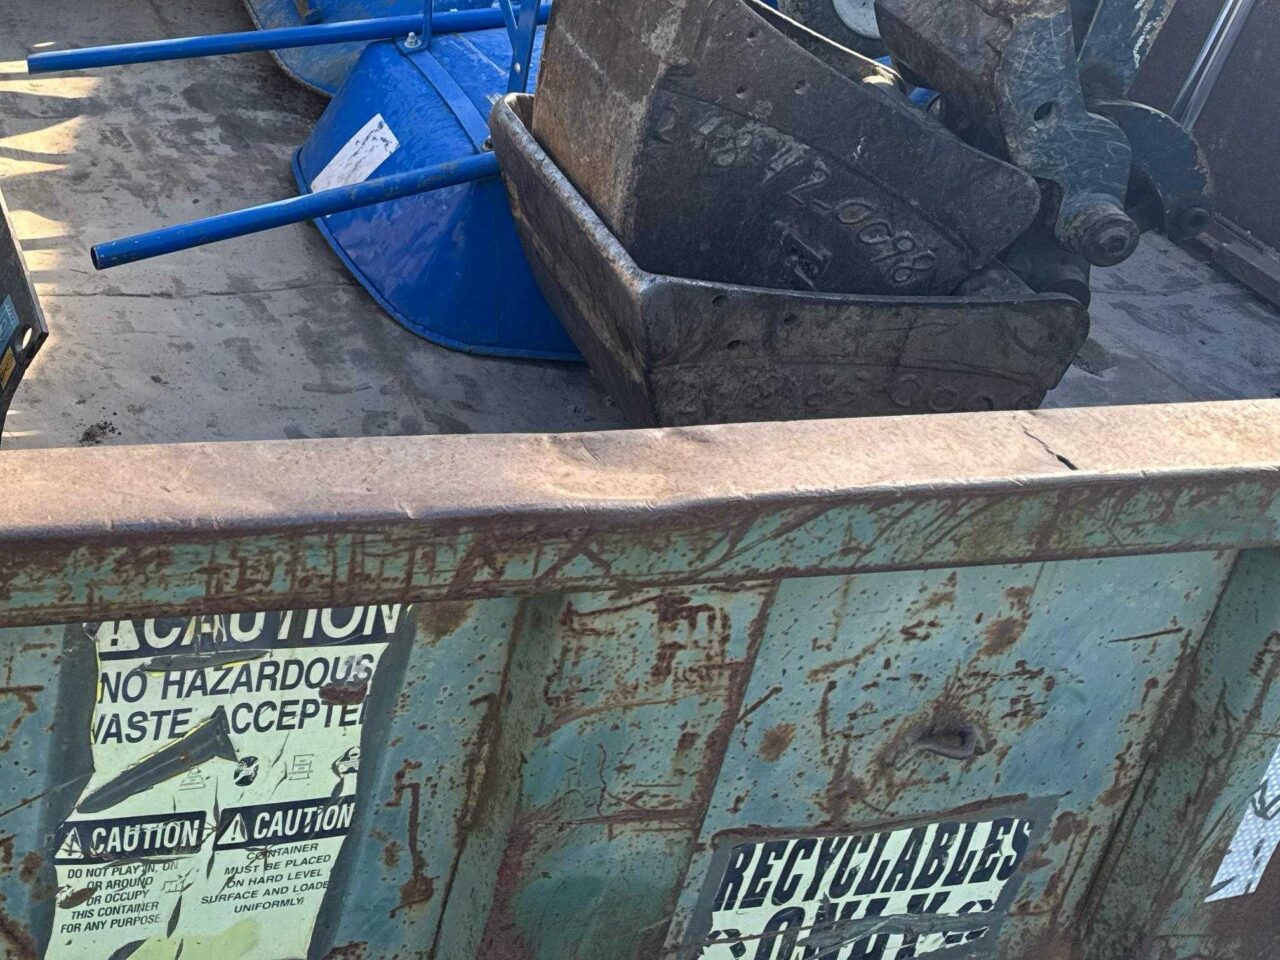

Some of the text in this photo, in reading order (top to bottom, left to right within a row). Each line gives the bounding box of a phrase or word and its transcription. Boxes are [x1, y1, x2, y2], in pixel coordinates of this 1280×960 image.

[98, 654, 374, 704] NO HAZARDOUS
[210, 697, 368, 736] ACCEPTE
[253, 803, 355, 840] CAUTION
[91, 819, 201, 854] CAUTION
[247, 843, 319, 861] CONTAINER
[67, 868, 83, 879] DO
[86, 866, 109, 878] NOT
[111, 864, 140, 877] PLAY
[162, 861, 179, 872] ON
[224, 854, 331, 876] MUST BE PLACED
[716, 816, 1033, 911] RECYCLABLES
[87, 876, 154, 891] OR AROUND
[227, 868, 323, 889] ON HARD LEVEL
[86, 889, 150, 907] OR OCCUPY
[201, 890, 259, 905] SURFACE
[262, 886, 289, 897] AND
[71, 901, 160, 920] THIS CONTAINER
[61, 923, 81, 934] FOR
[84, 920, 107, 932] ANY
